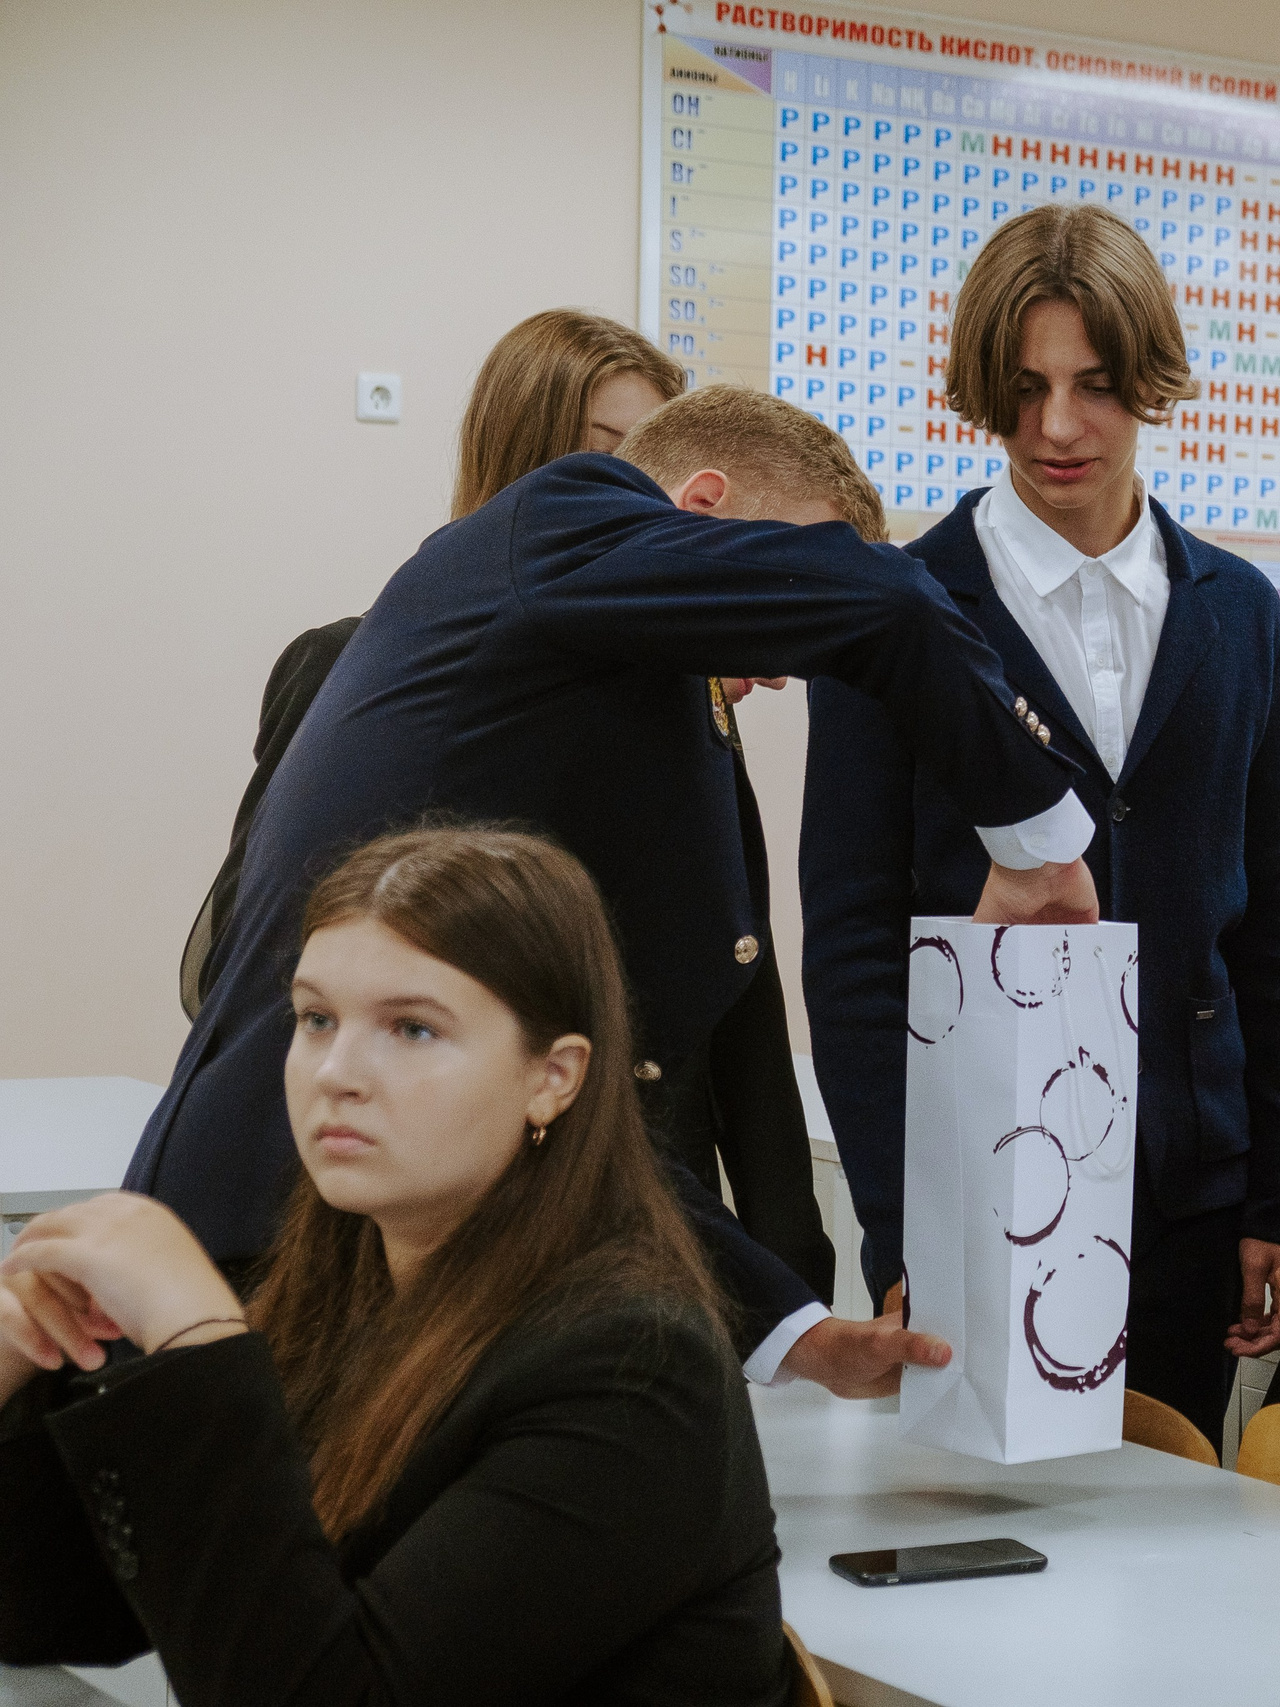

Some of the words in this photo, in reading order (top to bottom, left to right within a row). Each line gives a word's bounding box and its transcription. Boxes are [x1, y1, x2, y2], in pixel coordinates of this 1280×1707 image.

[715, 1, 934, 53] РАСТВОРИМОСТЬ
[1046, 50, 1183, 87] ОСНОВАНИЙ
[1208, 73, 1278, 103] СОЛЕЙ
